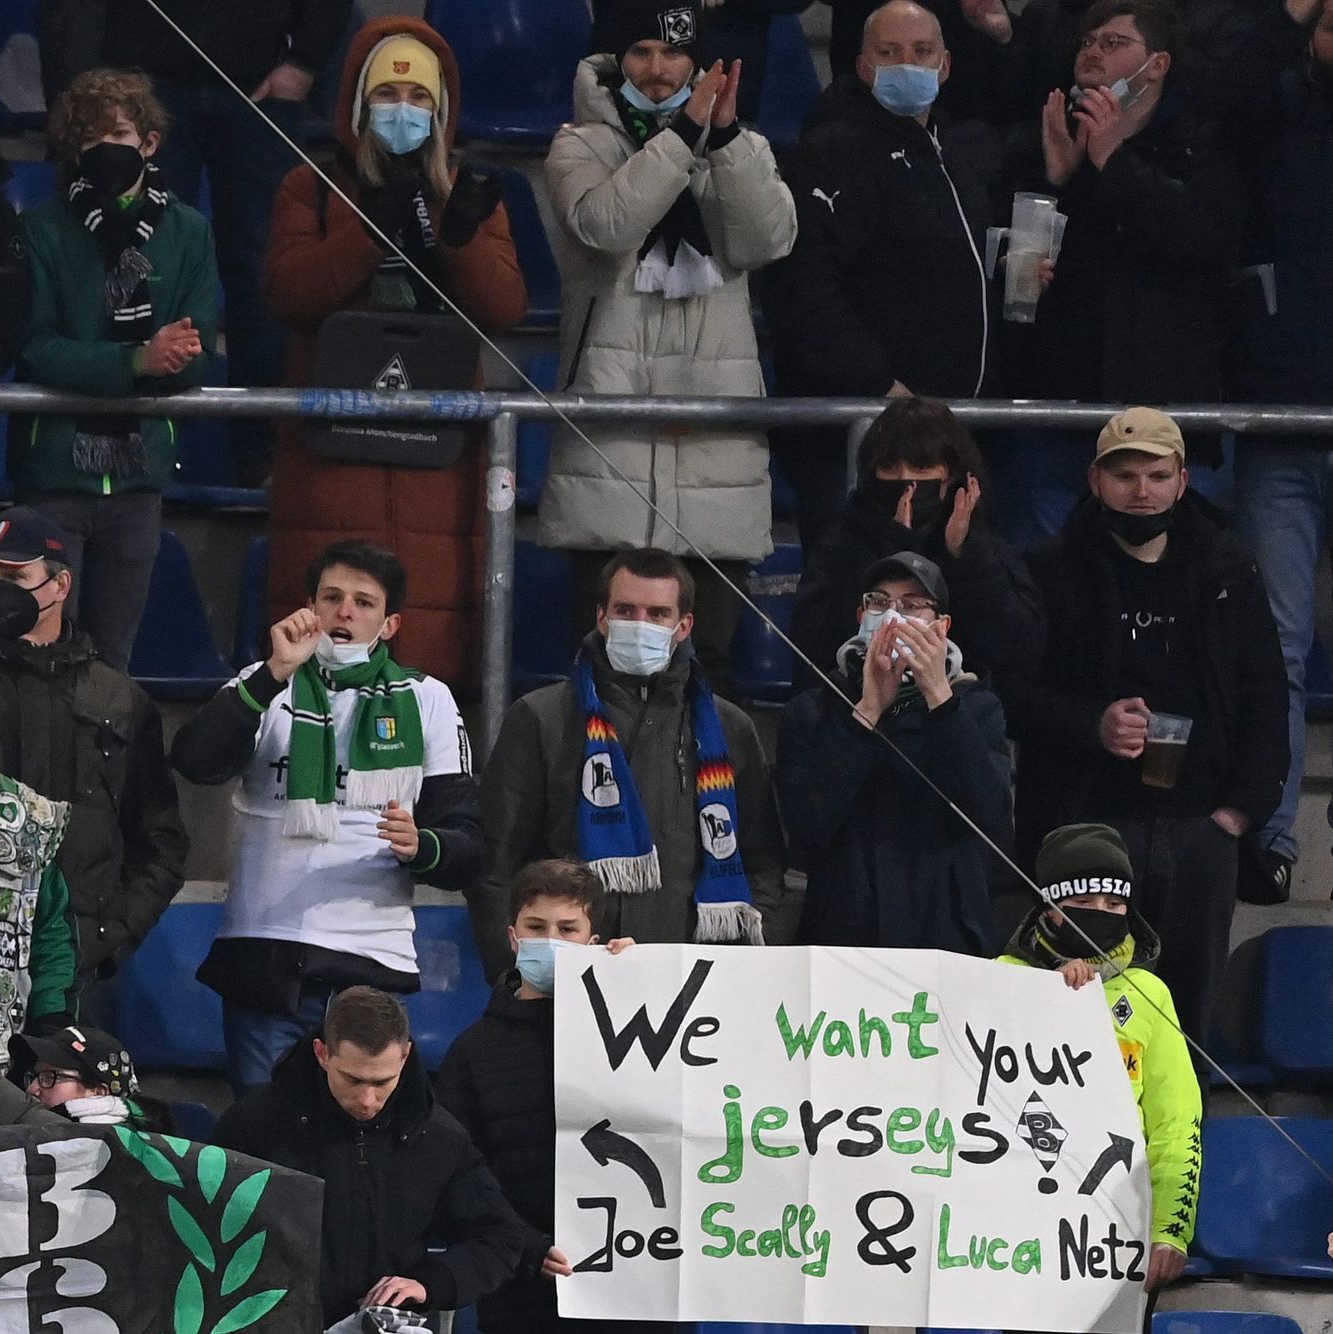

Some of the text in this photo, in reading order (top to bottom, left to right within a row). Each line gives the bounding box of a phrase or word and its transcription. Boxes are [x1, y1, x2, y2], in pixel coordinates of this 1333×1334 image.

[1041, 877, 1132, 903] BORUSSIA
[580, 959, 1092, 1106] We want your
[572, 1190, 1146, 1282] Joe Scally & Luca Netz
